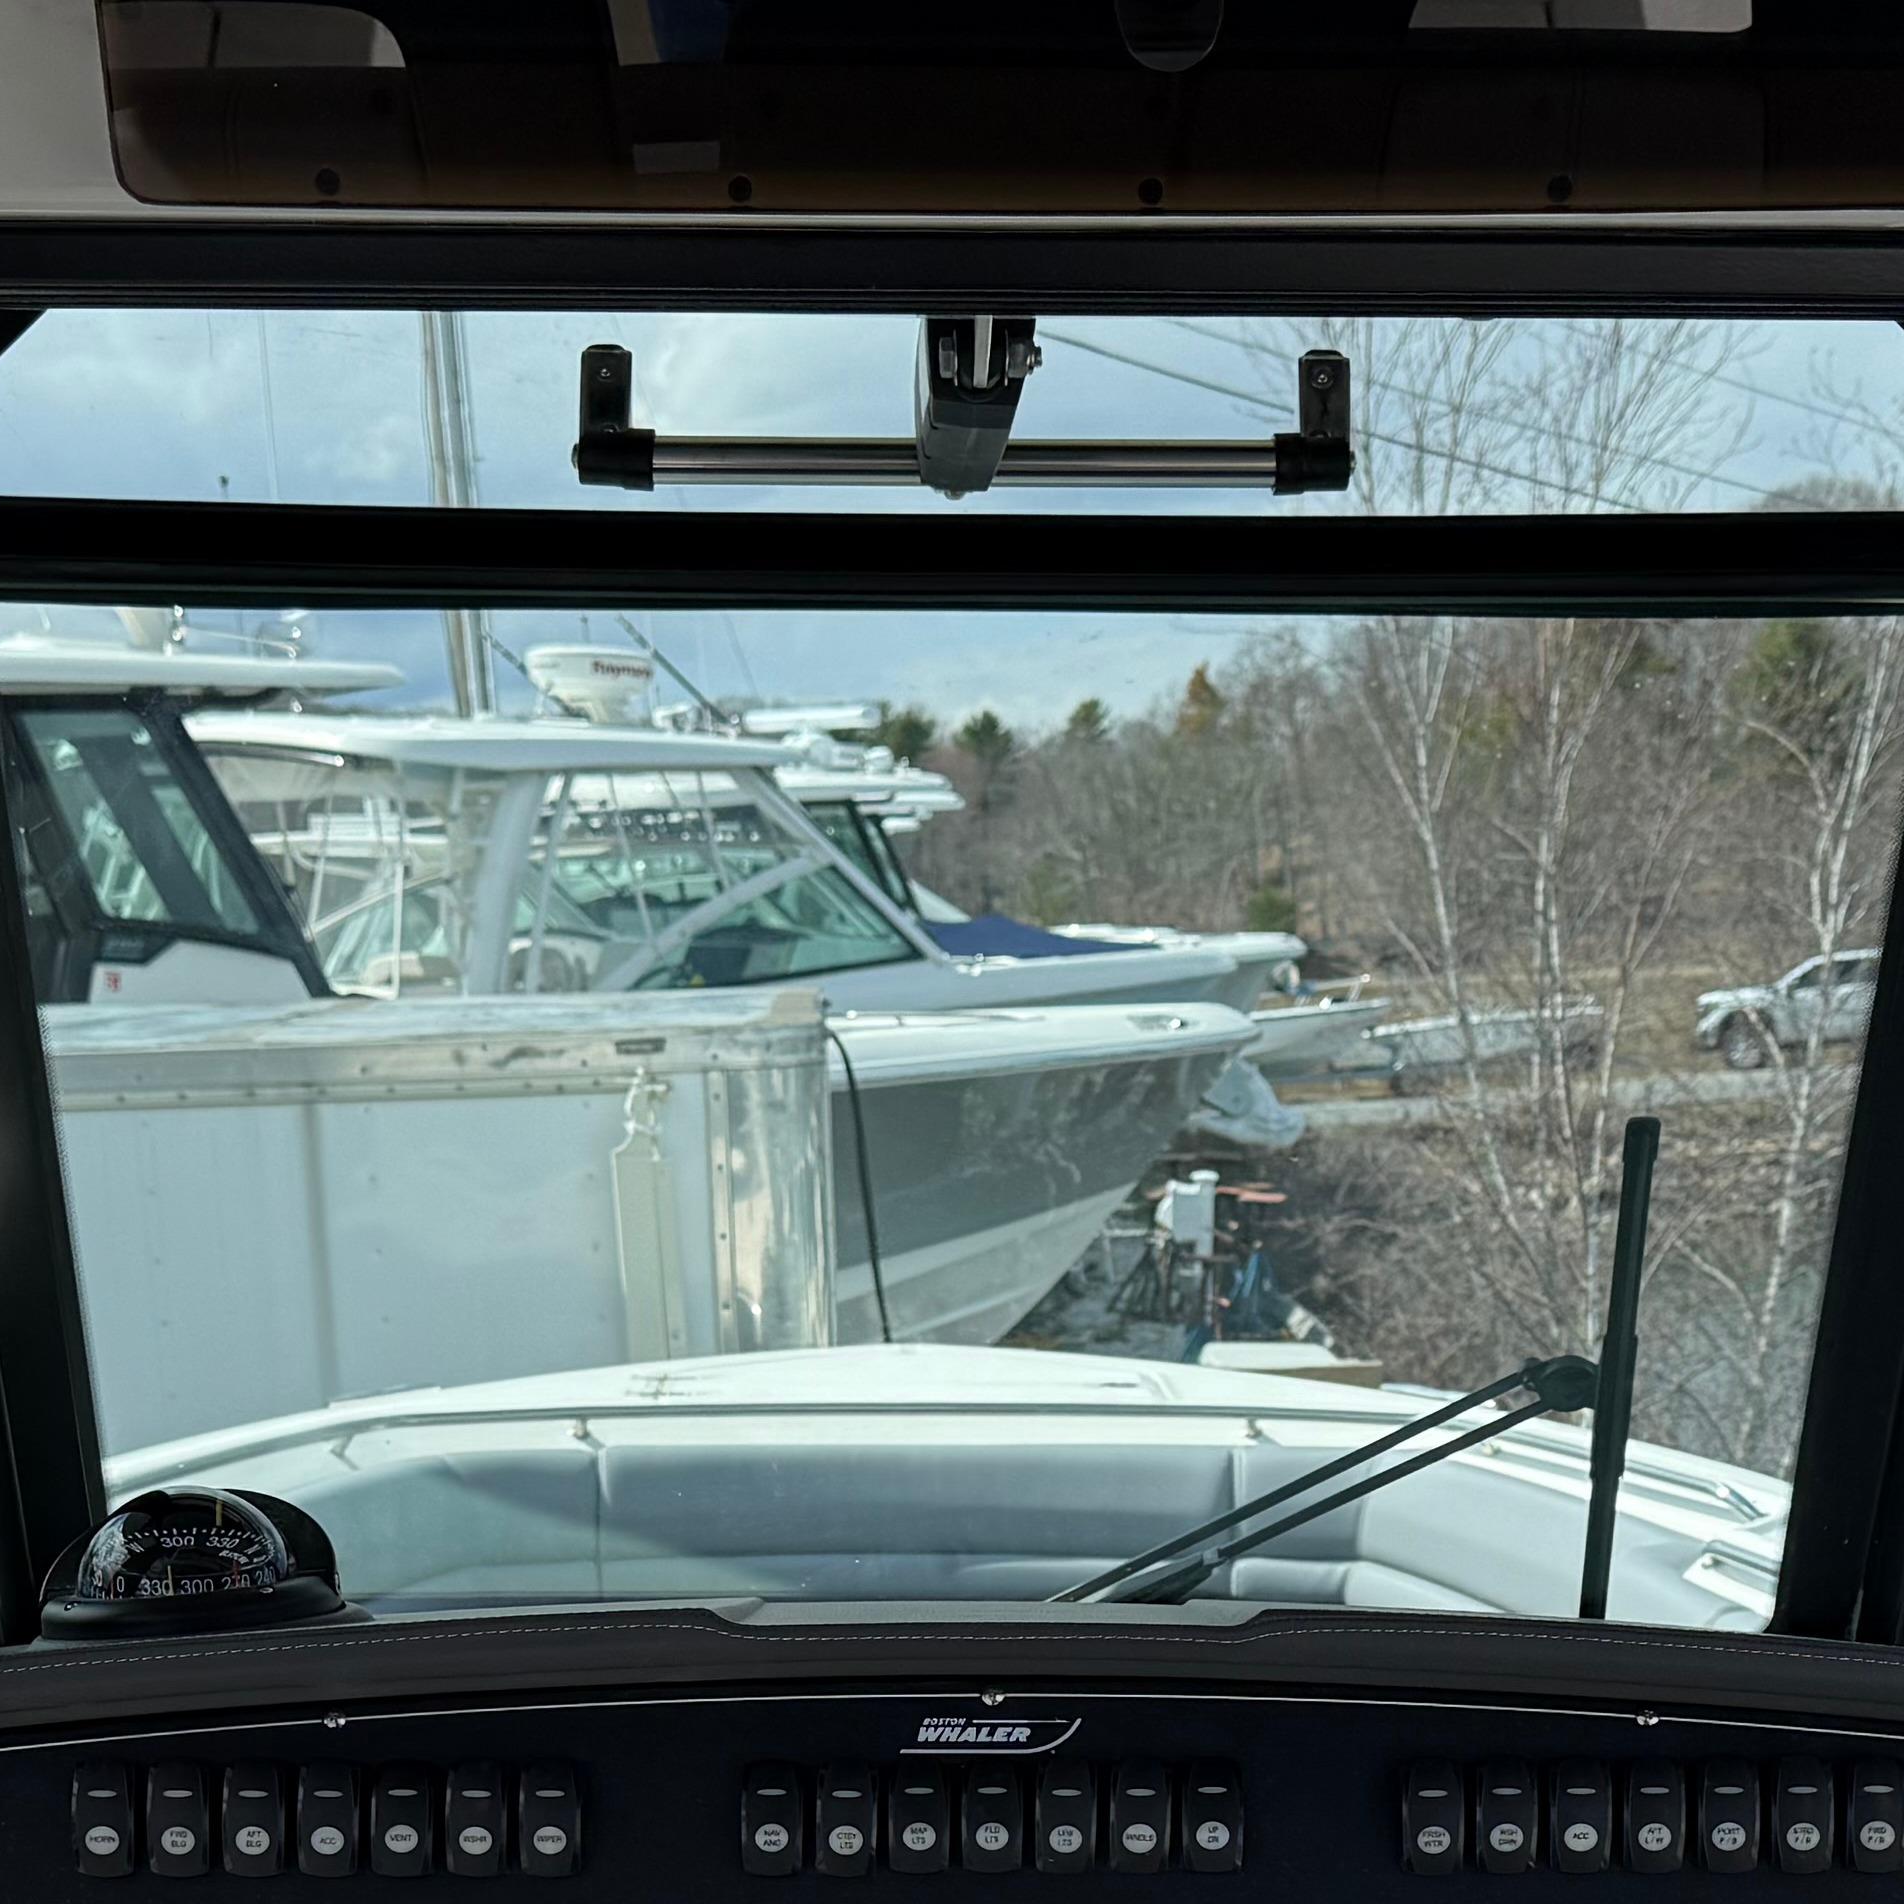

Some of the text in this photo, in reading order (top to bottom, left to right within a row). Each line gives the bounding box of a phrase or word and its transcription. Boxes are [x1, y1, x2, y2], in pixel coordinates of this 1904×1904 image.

[160, 1536, 195, 1548] 300
[206, 1536, 240, 1549] 330
[180, 1579, 214, 1595] 300
[923, 1717, 966, 1726] BOSTON
[917, 1726, 1031, 1742] WHALER
[247, 1830, 261, 1838] AFT
[389, 1834, 412, 1842] VENT
[1572, 1832, 1589, 1840] ACC
